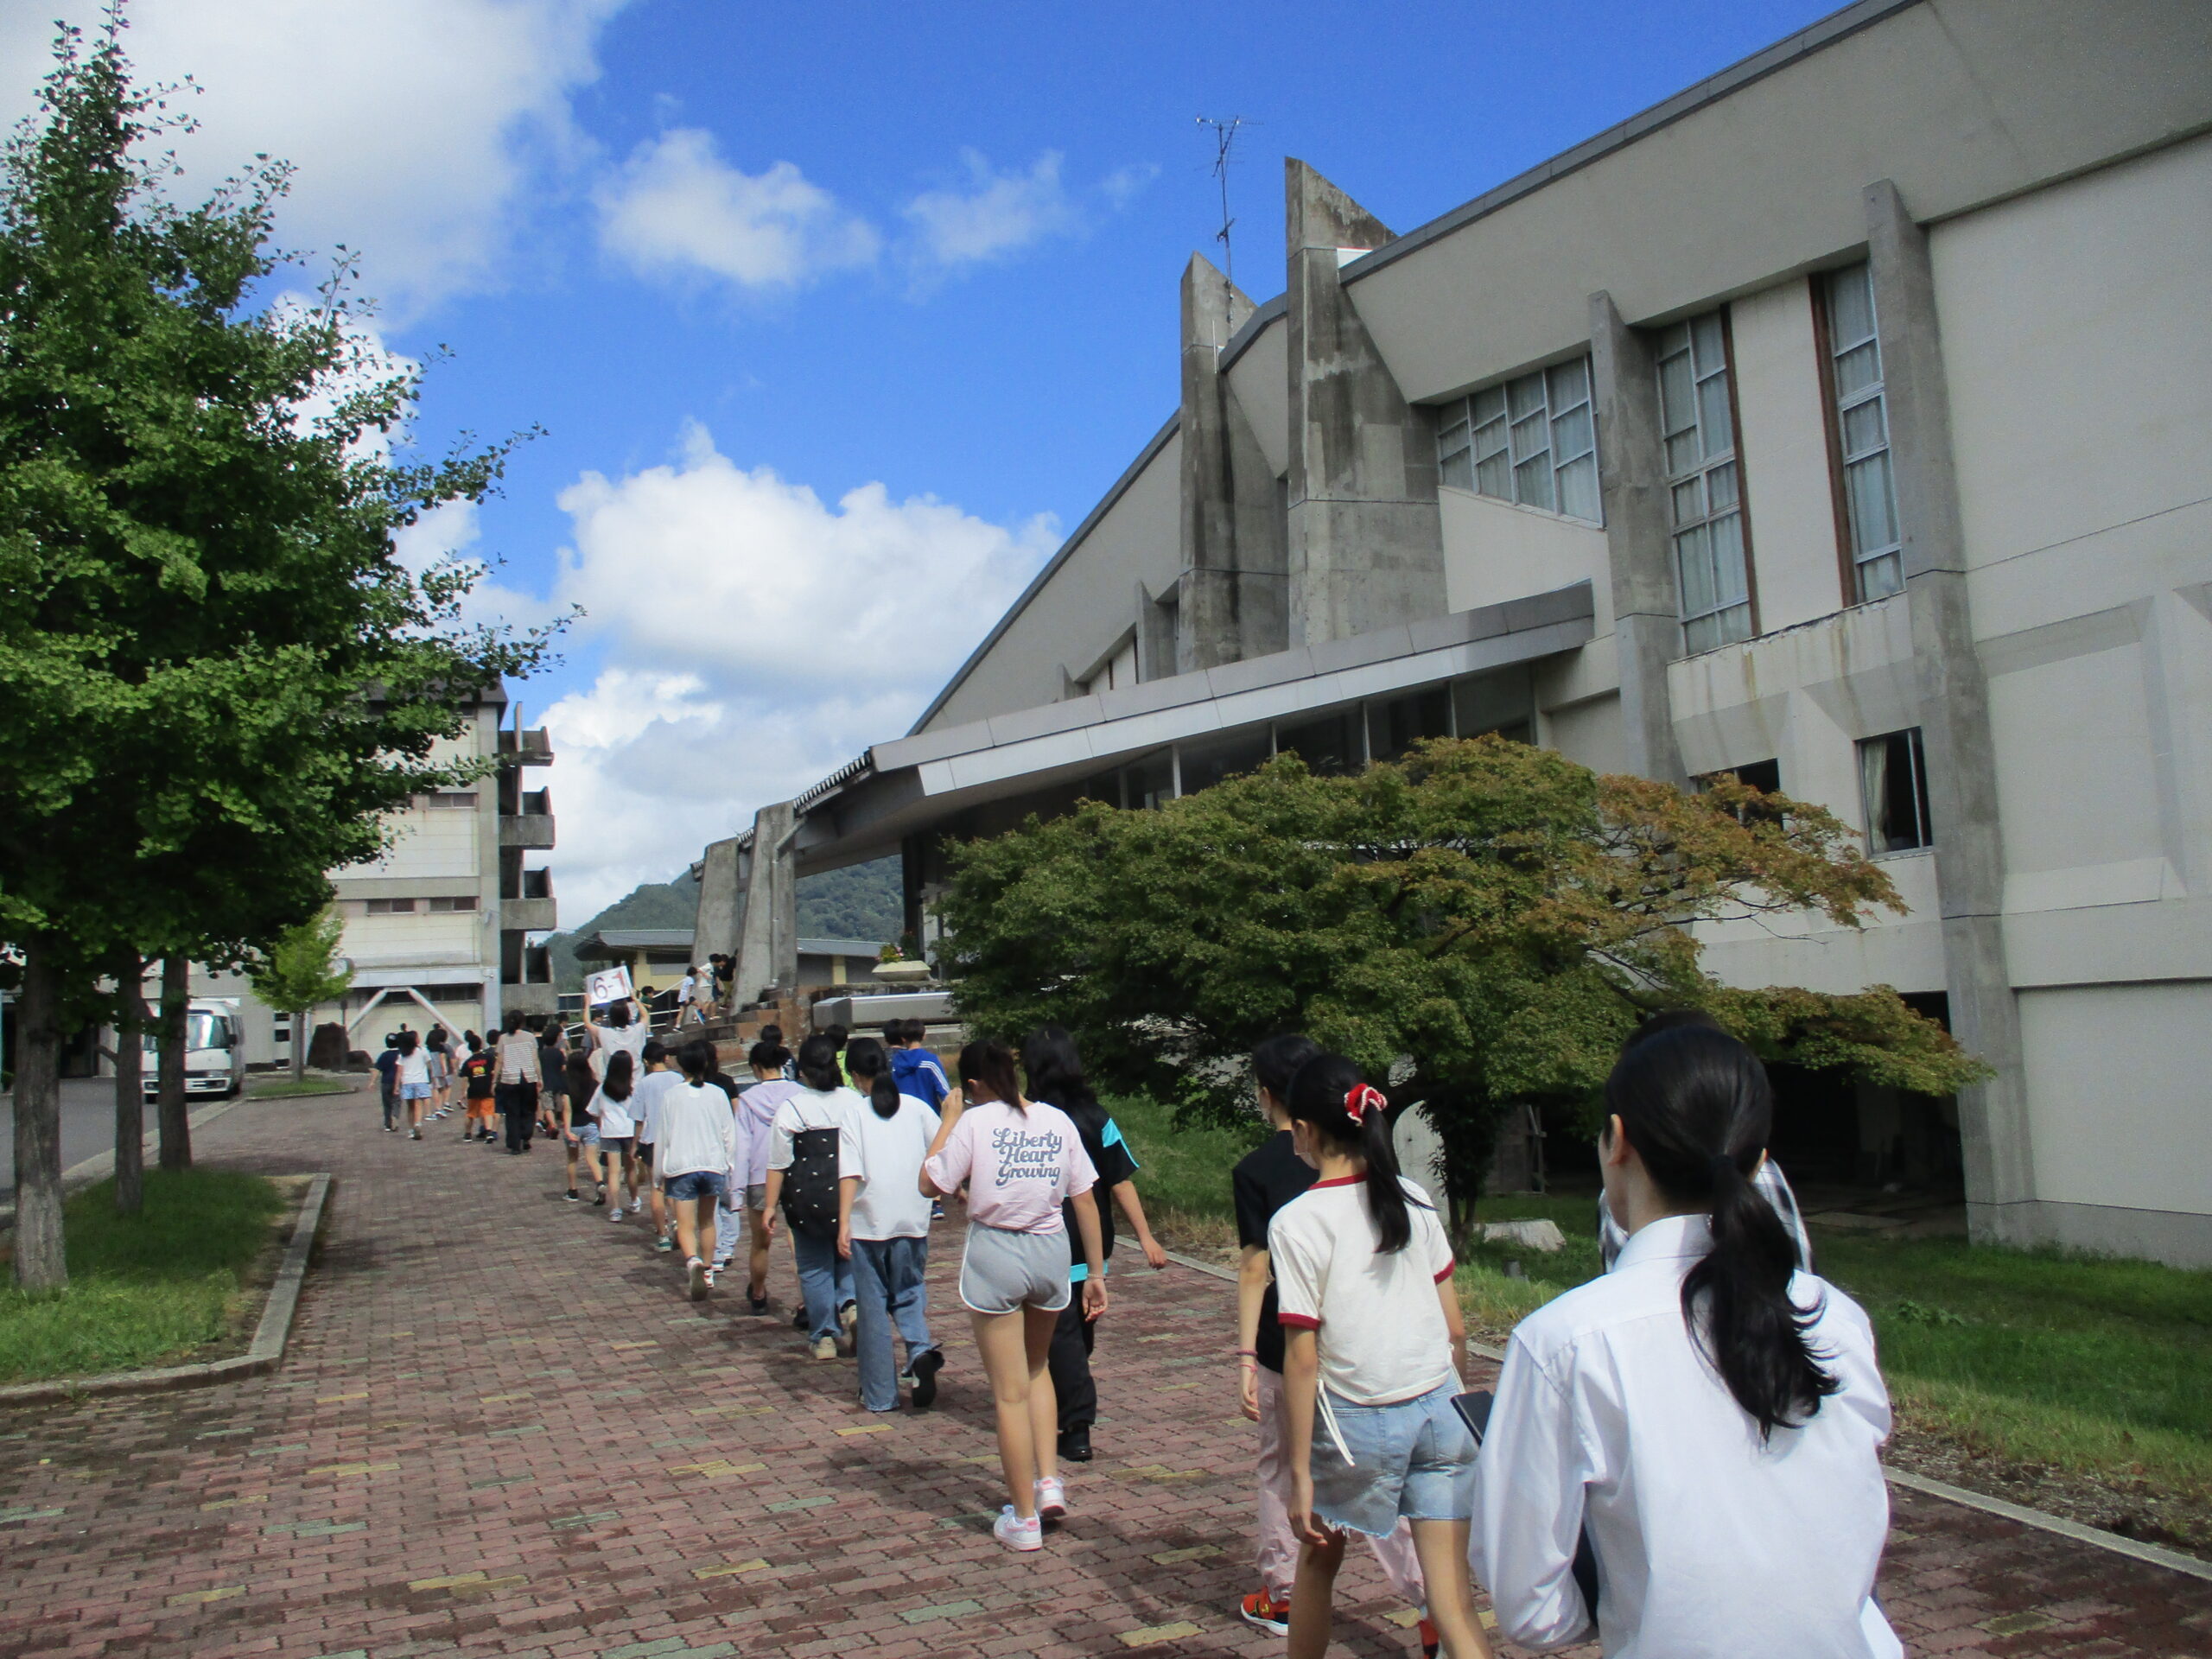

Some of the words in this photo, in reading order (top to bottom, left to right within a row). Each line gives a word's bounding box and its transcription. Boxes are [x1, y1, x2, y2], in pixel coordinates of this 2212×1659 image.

[992, 1128, 1063, 1154] Liberty
[999, 1145, 1055, 1164] Heart
[995, 1160, 1061, 1186] Growing
